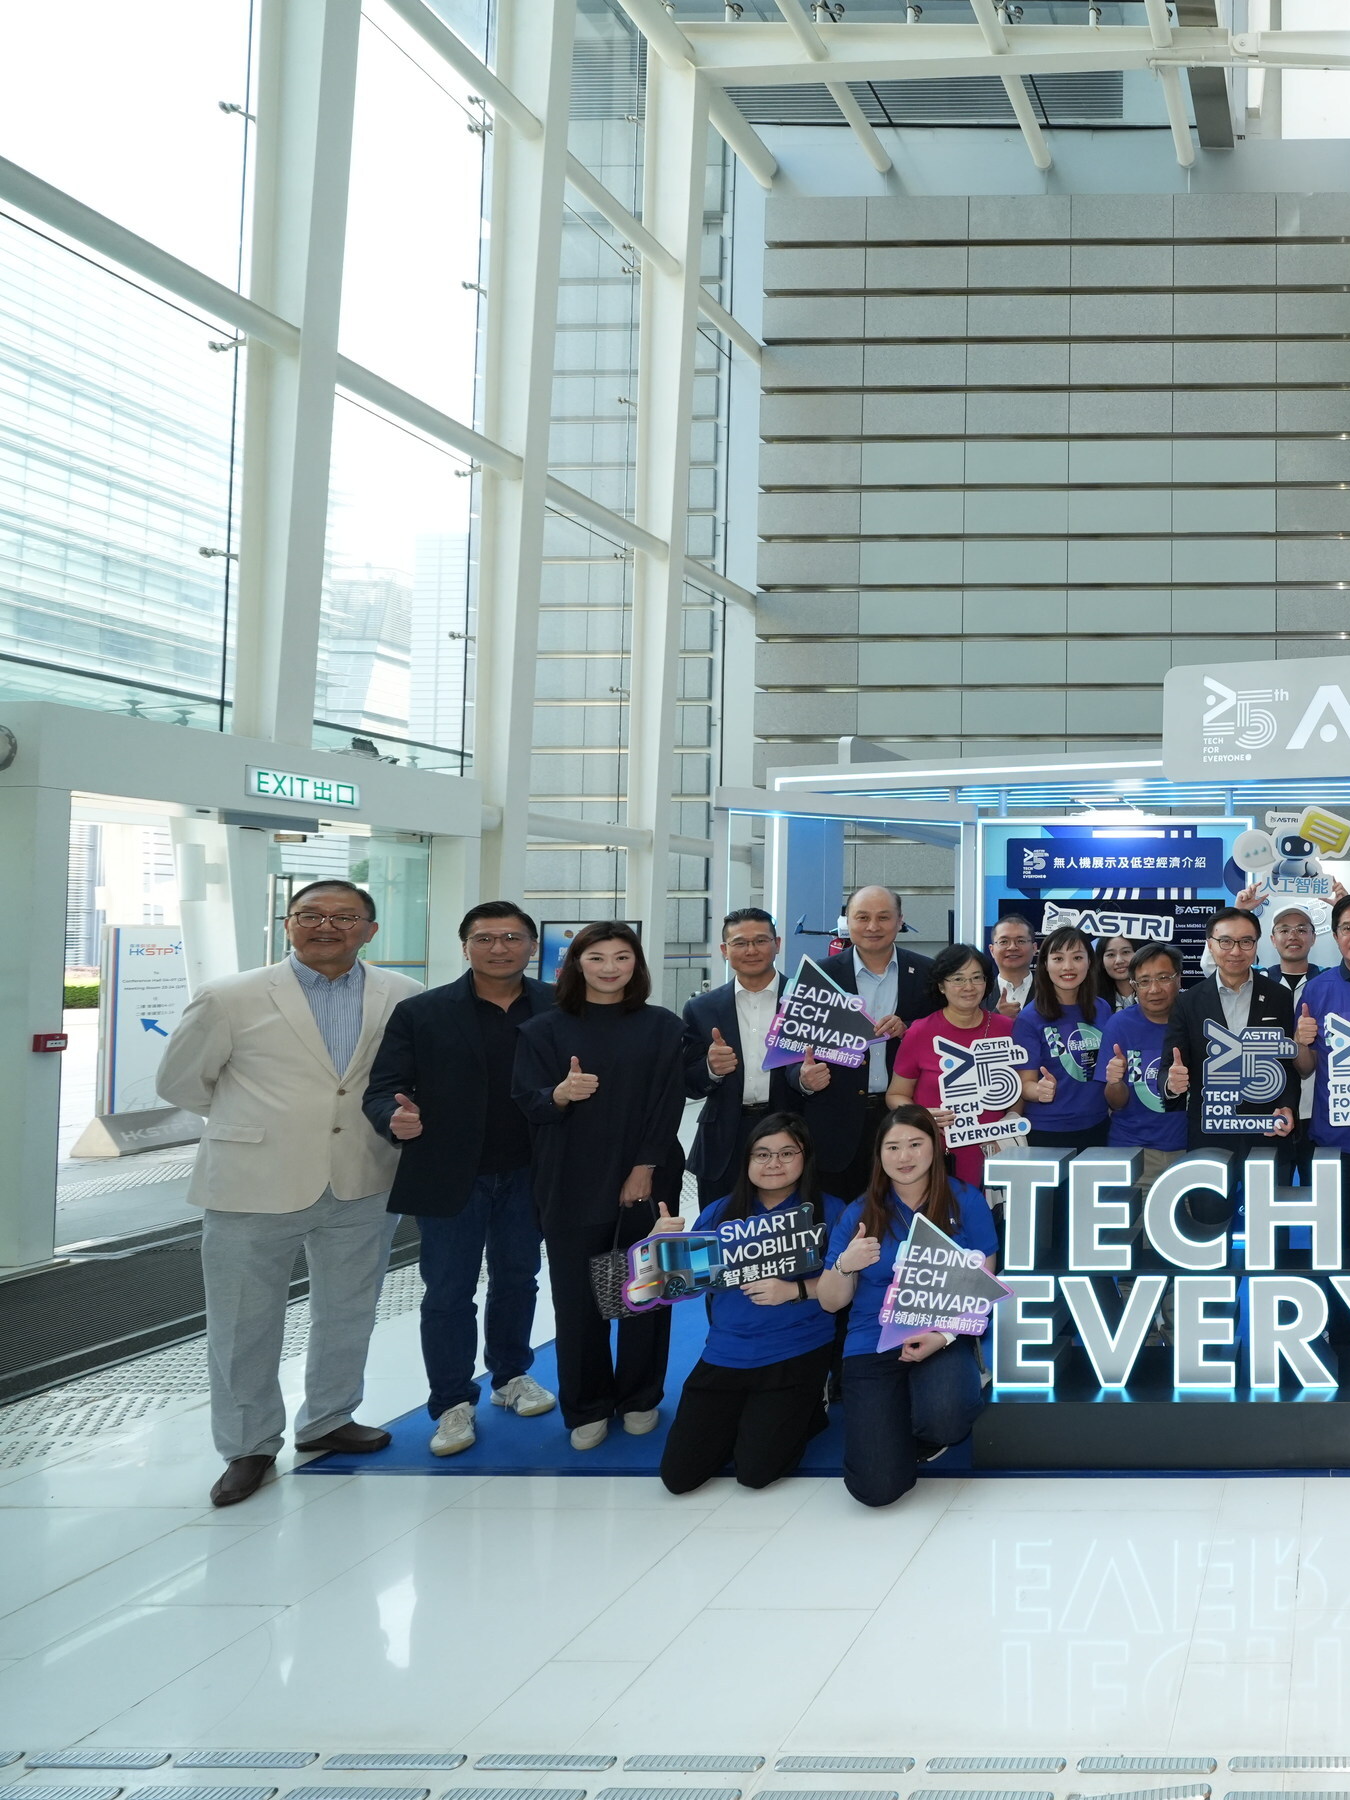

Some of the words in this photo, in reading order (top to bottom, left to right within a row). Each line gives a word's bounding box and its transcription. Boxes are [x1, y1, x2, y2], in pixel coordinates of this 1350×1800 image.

[1203, 737, 1224, 745] TECH
[1203, 746, 1219, 754] FOR
[1203, 753, 1245, 763] EVERYONE
[257, 771, 309, 798] EXIT
[314, 781, 354, 805] 出口
[1053, 857, 1206, 869] 無人機展示及低空經濟介紹
[1260, 877, 1329, 894] 人工智能
[1184, 906, 1216, 914] ASTRI
[1076, 913, 1170, 938] ASTRI
[129, 948, 173, 956] HKSTP
[787, 983, 863, 1012] LEADING
[781, 1000, 830, 1023] TECH
[773, 1017, 867, 1051] FORWARD
[1242, 1031, 1281, 1040] ASTRI
[974, 1040, 1010, 1052] ASTRI
[1206, 1091, 1239, 1101] TECH
[1206, 1105, 1232, 1115] FOR
[950, 1123, 1017, 1144] EVERYONE
[1205, 1119, 1273, 1130] EVERYONE
[984, 1159, 1342, 1271] TECH
[720, 1211, 799, 1243] SMART
[722, 1228, 824, 1265] MOBILITY
[900, 1244, 983, 1269] LEADING
[722, 1257, 797, 1287] 智慧出行
[896, 1266, 948, 1288] TECH
[887, 1288, 990, 1315] FORWARD
[882, 1309, 932, 1327] 引領創科
